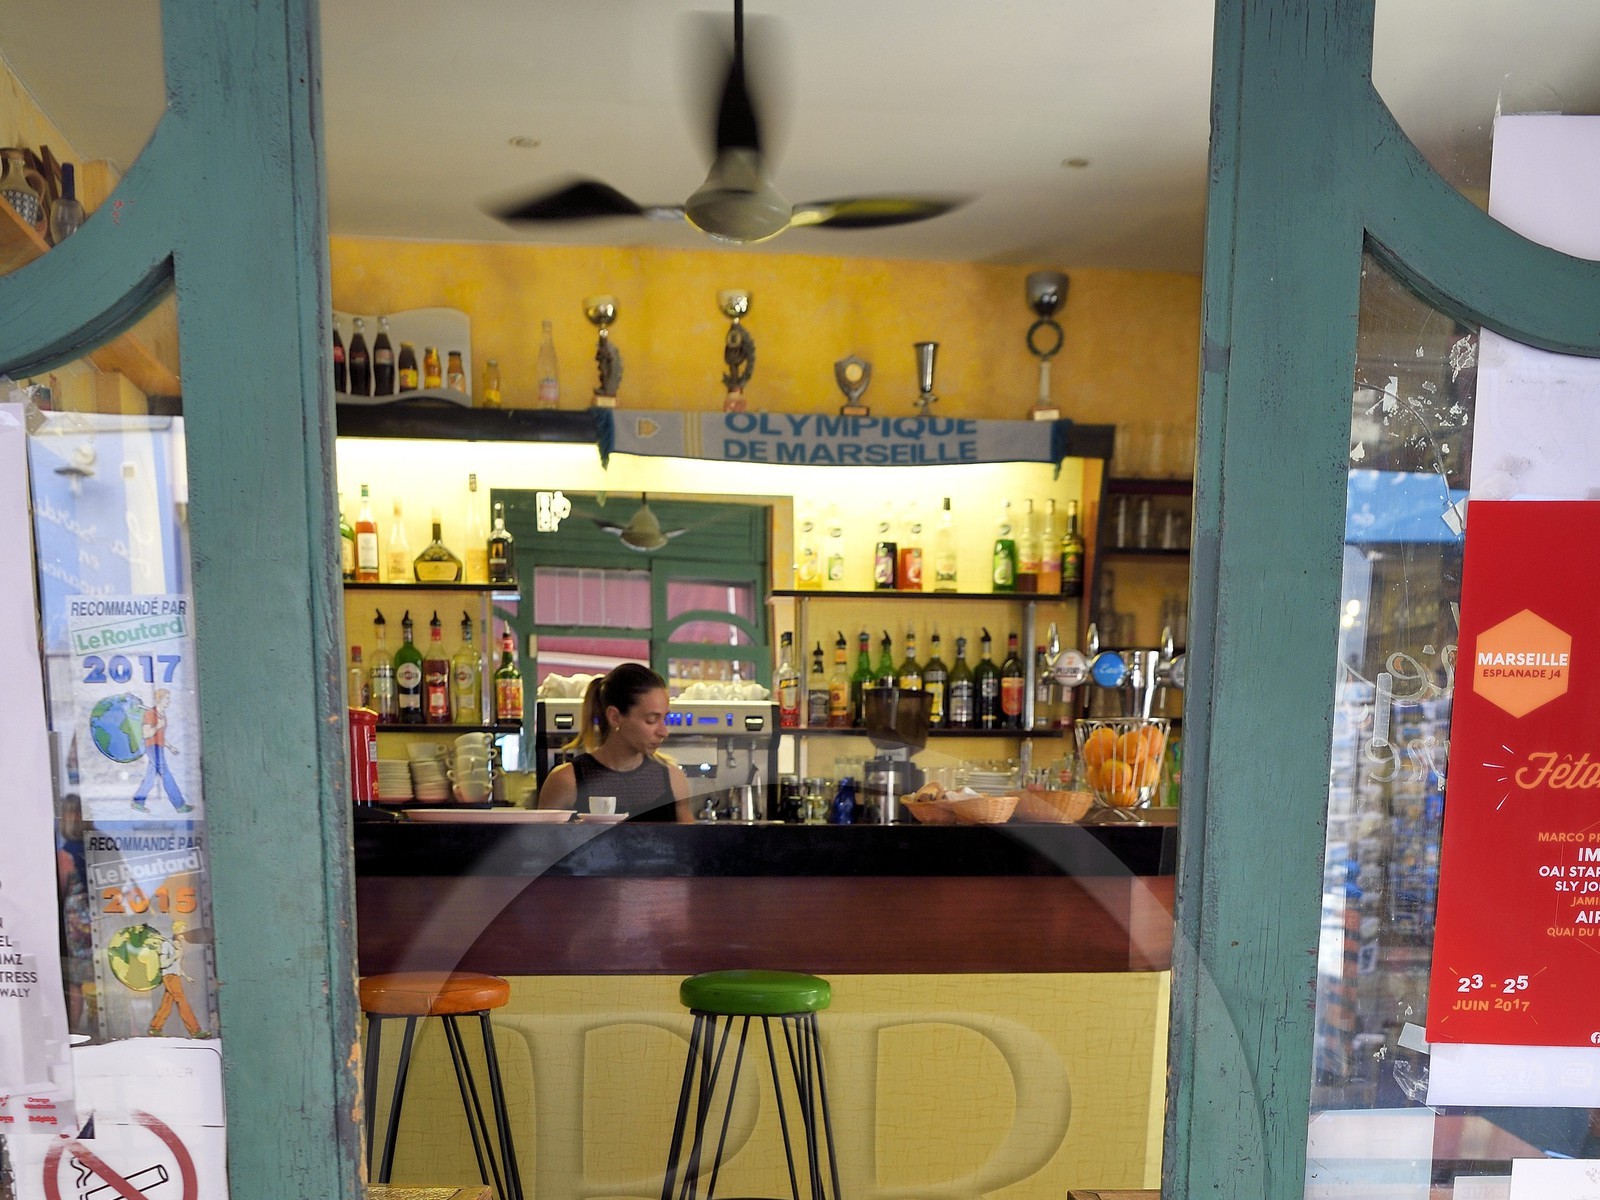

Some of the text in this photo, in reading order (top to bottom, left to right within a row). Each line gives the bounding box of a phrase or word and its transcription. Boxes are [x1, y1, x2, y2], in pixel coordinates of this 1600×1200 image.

[724, 413, 978, 439] OLYMPIQUE
[723, 439, 977, 464] DE MARSEILLE
[71, 597, 187, 616] RECOMMANDÉ PAR
[100, 616, 184, 646] Routard
[1477, 652, 1569, 667] MARSEILLE
[83, 654, 182, 684] 2017
[1483, 669, 1561, 680] ESPLANADE J4
[89, 833, 203, 851] RECOMMANDÉ PAR
[1538, 832, 1584, 842] MARCO
[1578, 847, 1600, 862] IM
[1538, 865, 1565, 877] OAI
[1555, 880, 1600, 894] SLY JO
[103, 885, 198, 914] 2015
[1570, 896, 1600, 907] JAMI
[1547, 927, 1594, 937] QUAI DU
[1457, 974, 1484, 993] 23
[1502, 975, 1529, 994] 25
[1452, 998, 1530, 1012] JUIN 2017
